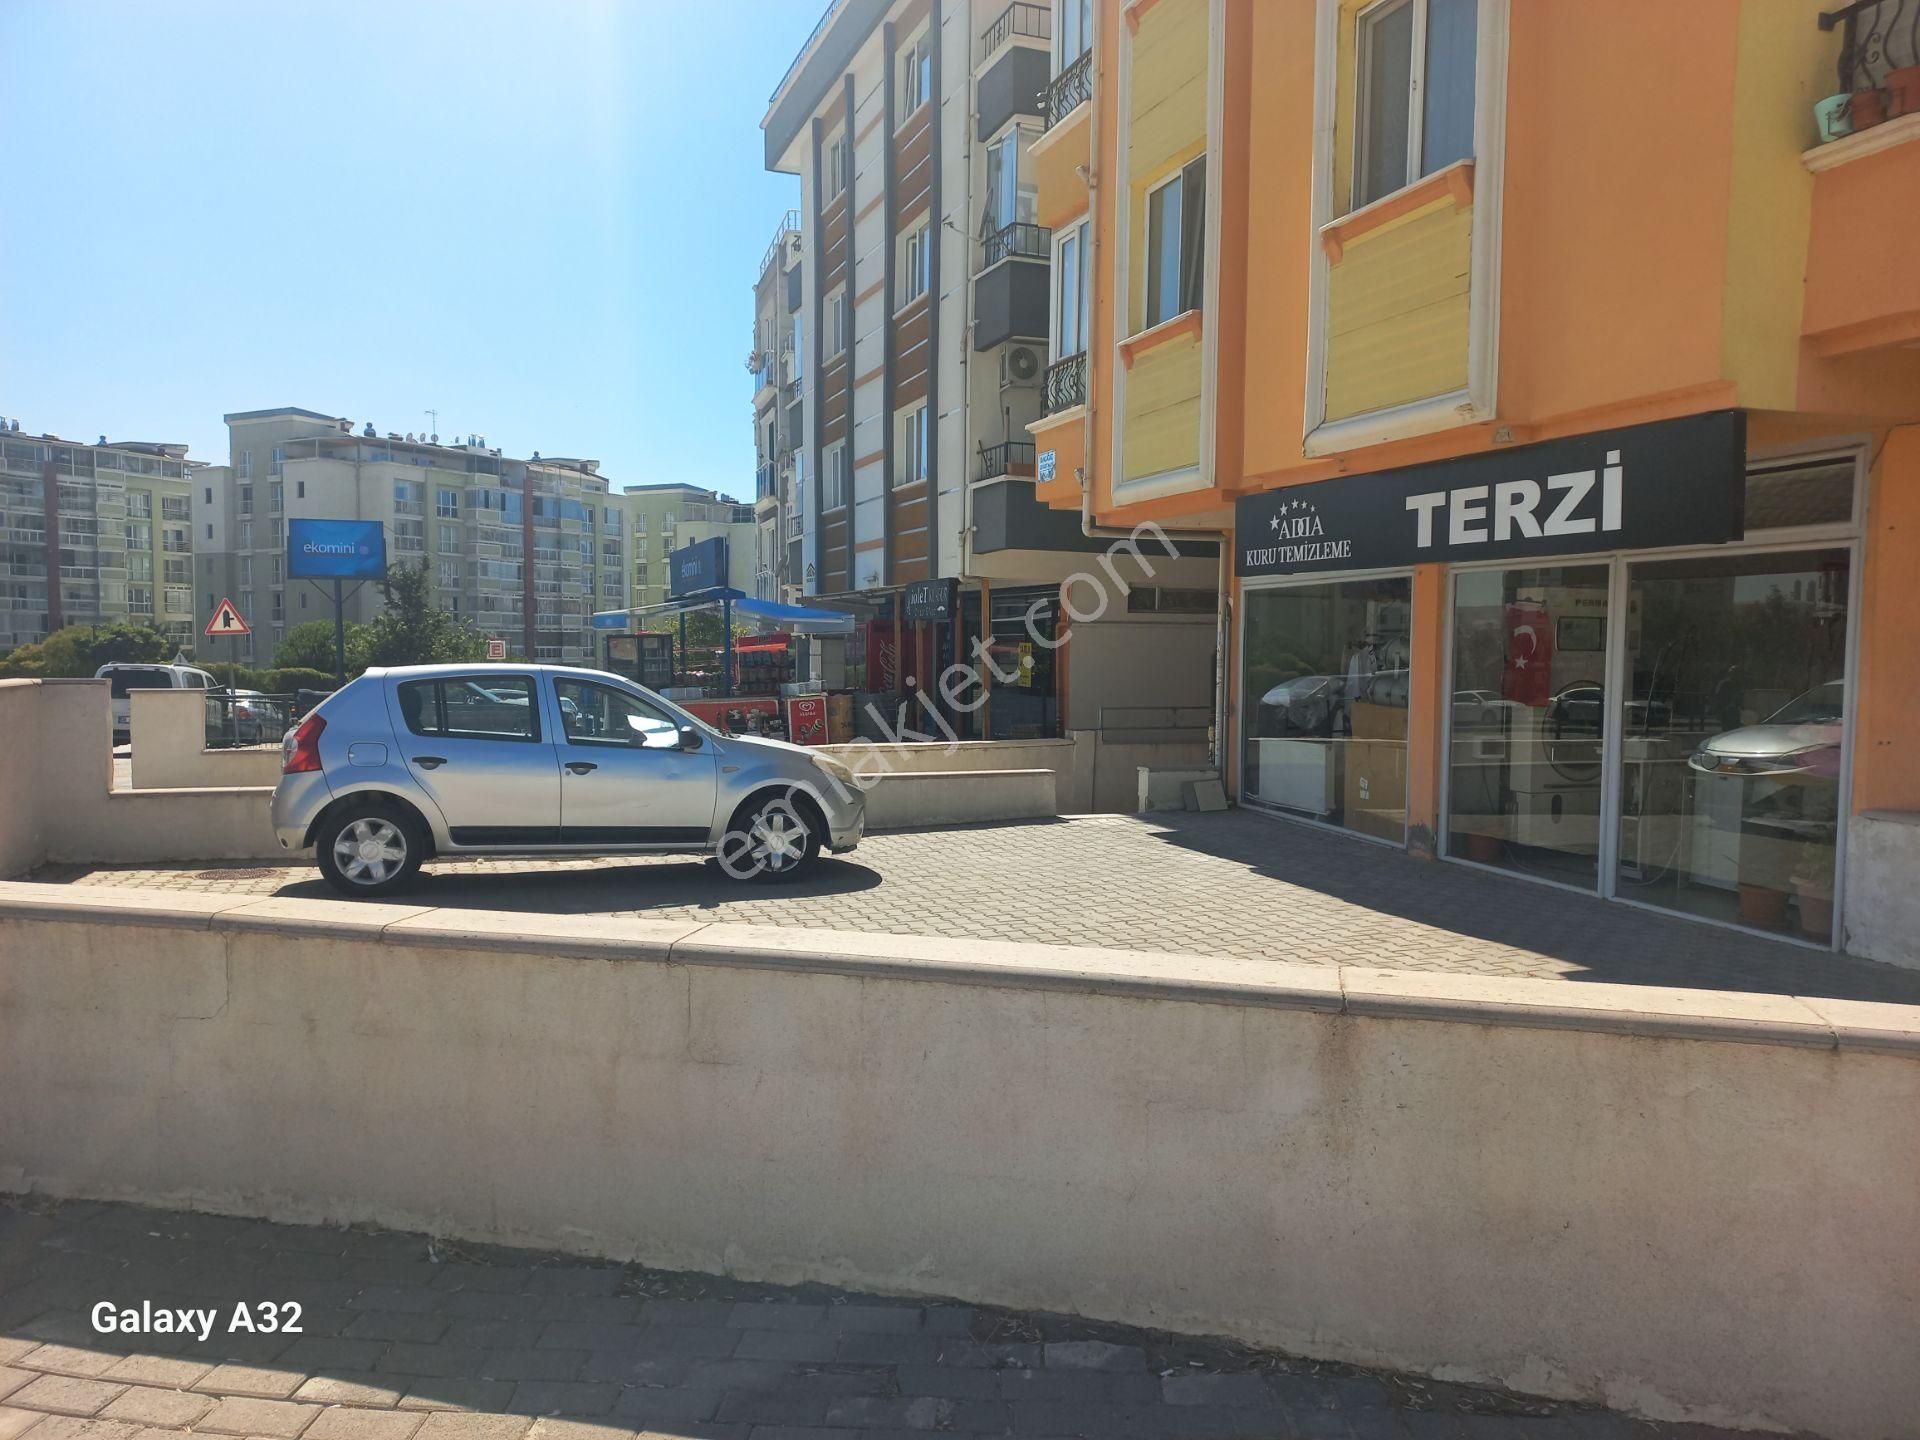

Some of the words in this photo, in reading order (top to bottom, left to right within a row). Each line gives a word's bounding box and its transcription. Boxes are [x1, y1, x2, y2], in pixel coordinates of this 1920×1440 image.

[1405, 449, 1623, 548] TERZİ
[303, 541, 356, 554] ekomini
[1246, 547, 1277, 566] KURU
[1278, 540, 1352, 563] TEMİZLEME
